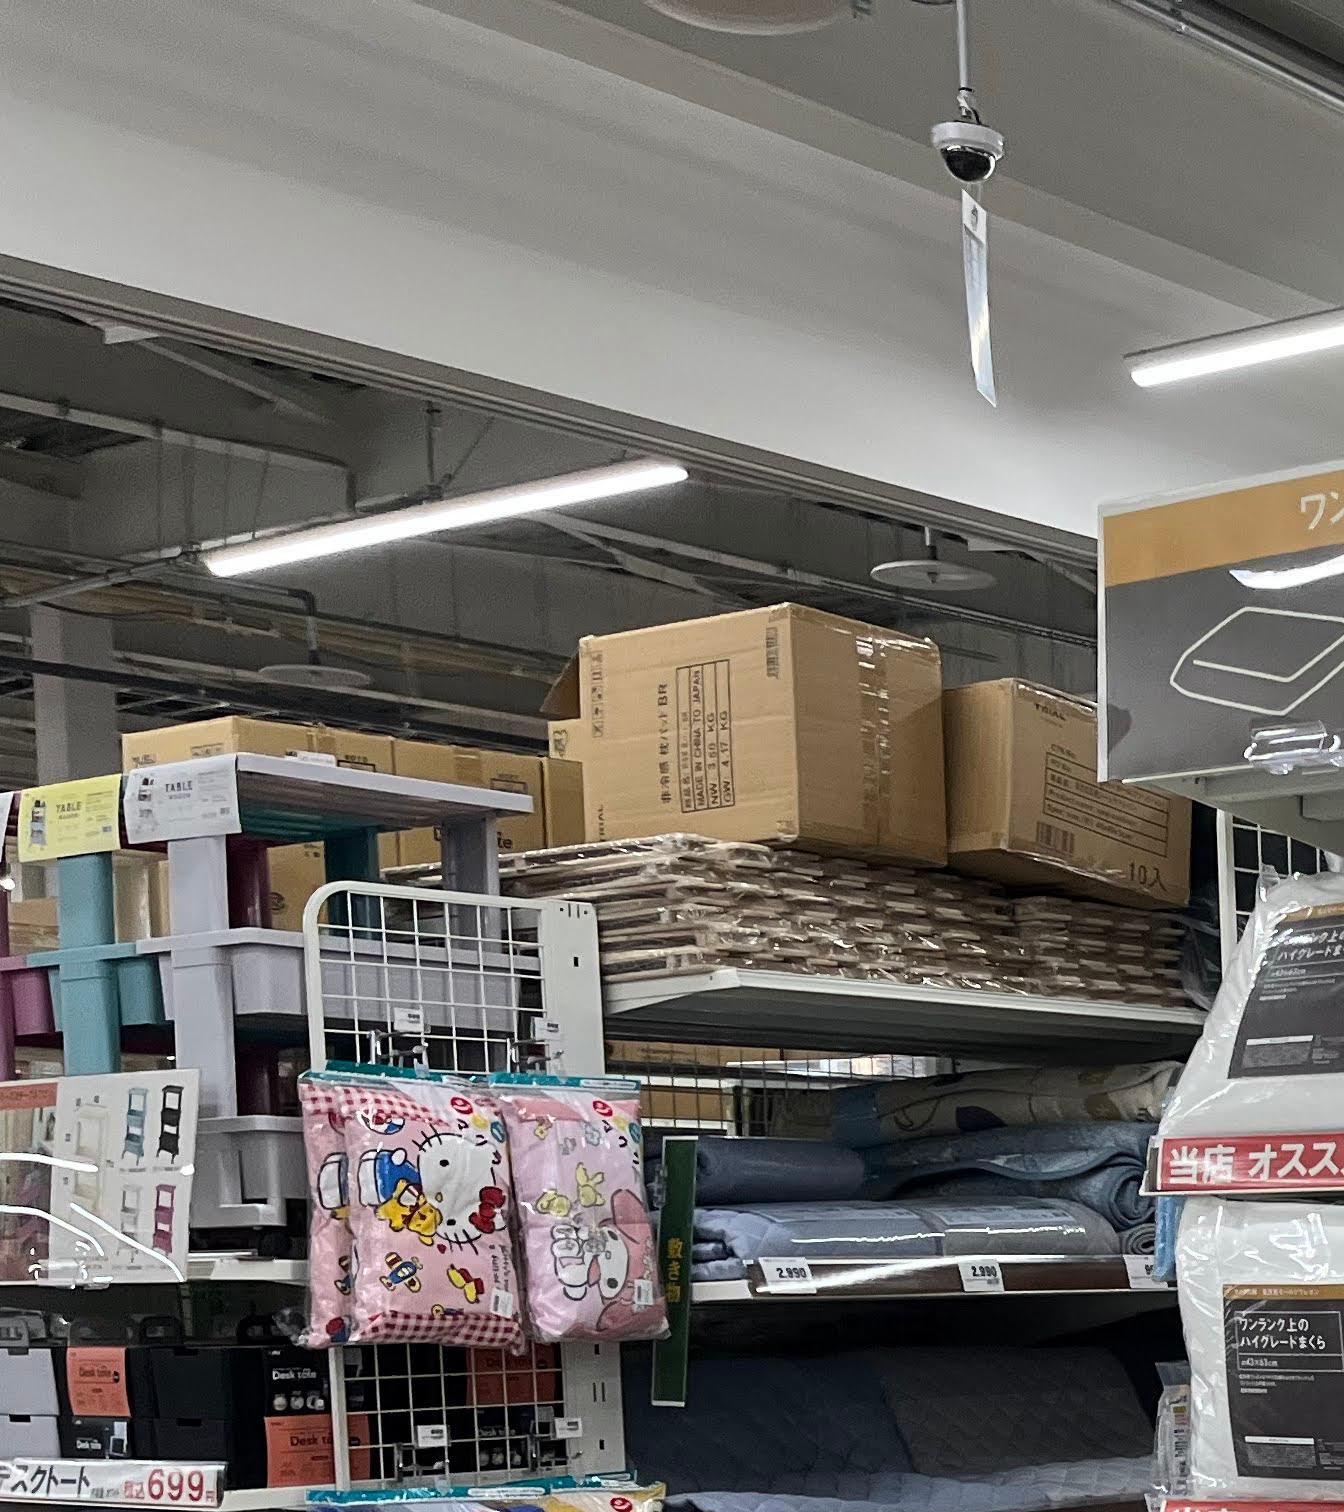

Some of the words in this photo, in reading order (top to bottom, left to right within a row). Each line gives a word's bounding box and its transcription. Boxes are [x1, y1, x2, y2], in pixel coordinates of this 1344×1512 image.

[164, 780, 193, 793] TABLE
[56, 801, 82, 814] TABLE
[1128, 860, 1169, 892] 10入
[1169, 1144, 1234, 1185] 当店
[1239, 1317, 1309, 1333] ワンランク上の
[1238, 1335, 1326, 1351] ハイグレードまくら
[272, 1368, 295, 1380] Desk
[289, 1434, 318, 1447] Desk
[147, 1467, 206, 1502] 699
